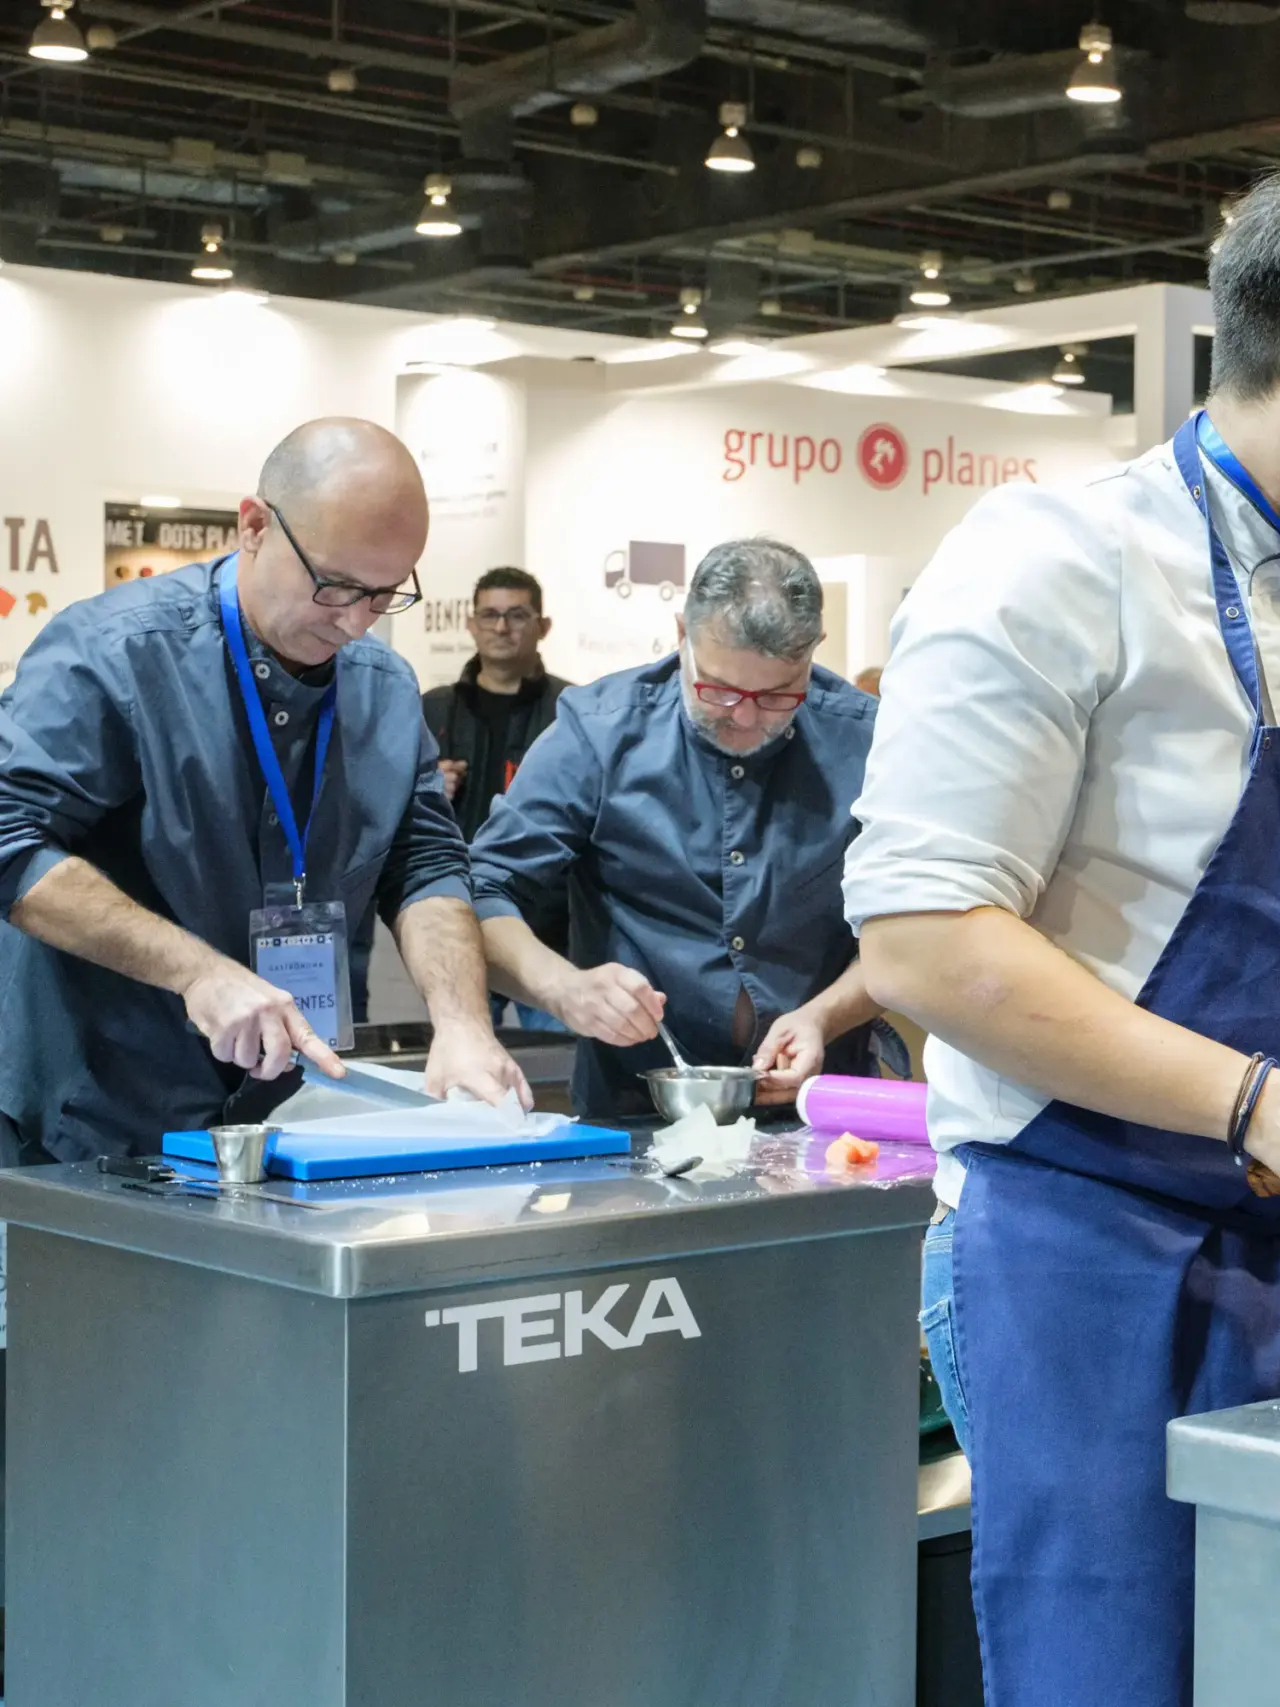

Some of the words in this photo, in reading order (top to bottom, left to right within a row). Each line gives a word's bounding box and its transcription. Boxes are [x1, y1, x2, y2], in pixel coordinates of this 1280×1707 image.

[722, 428, 842, 484] grupo
[922, 435, 1038, 496] planes
[425, 1276, 702, 1373] TEKA
